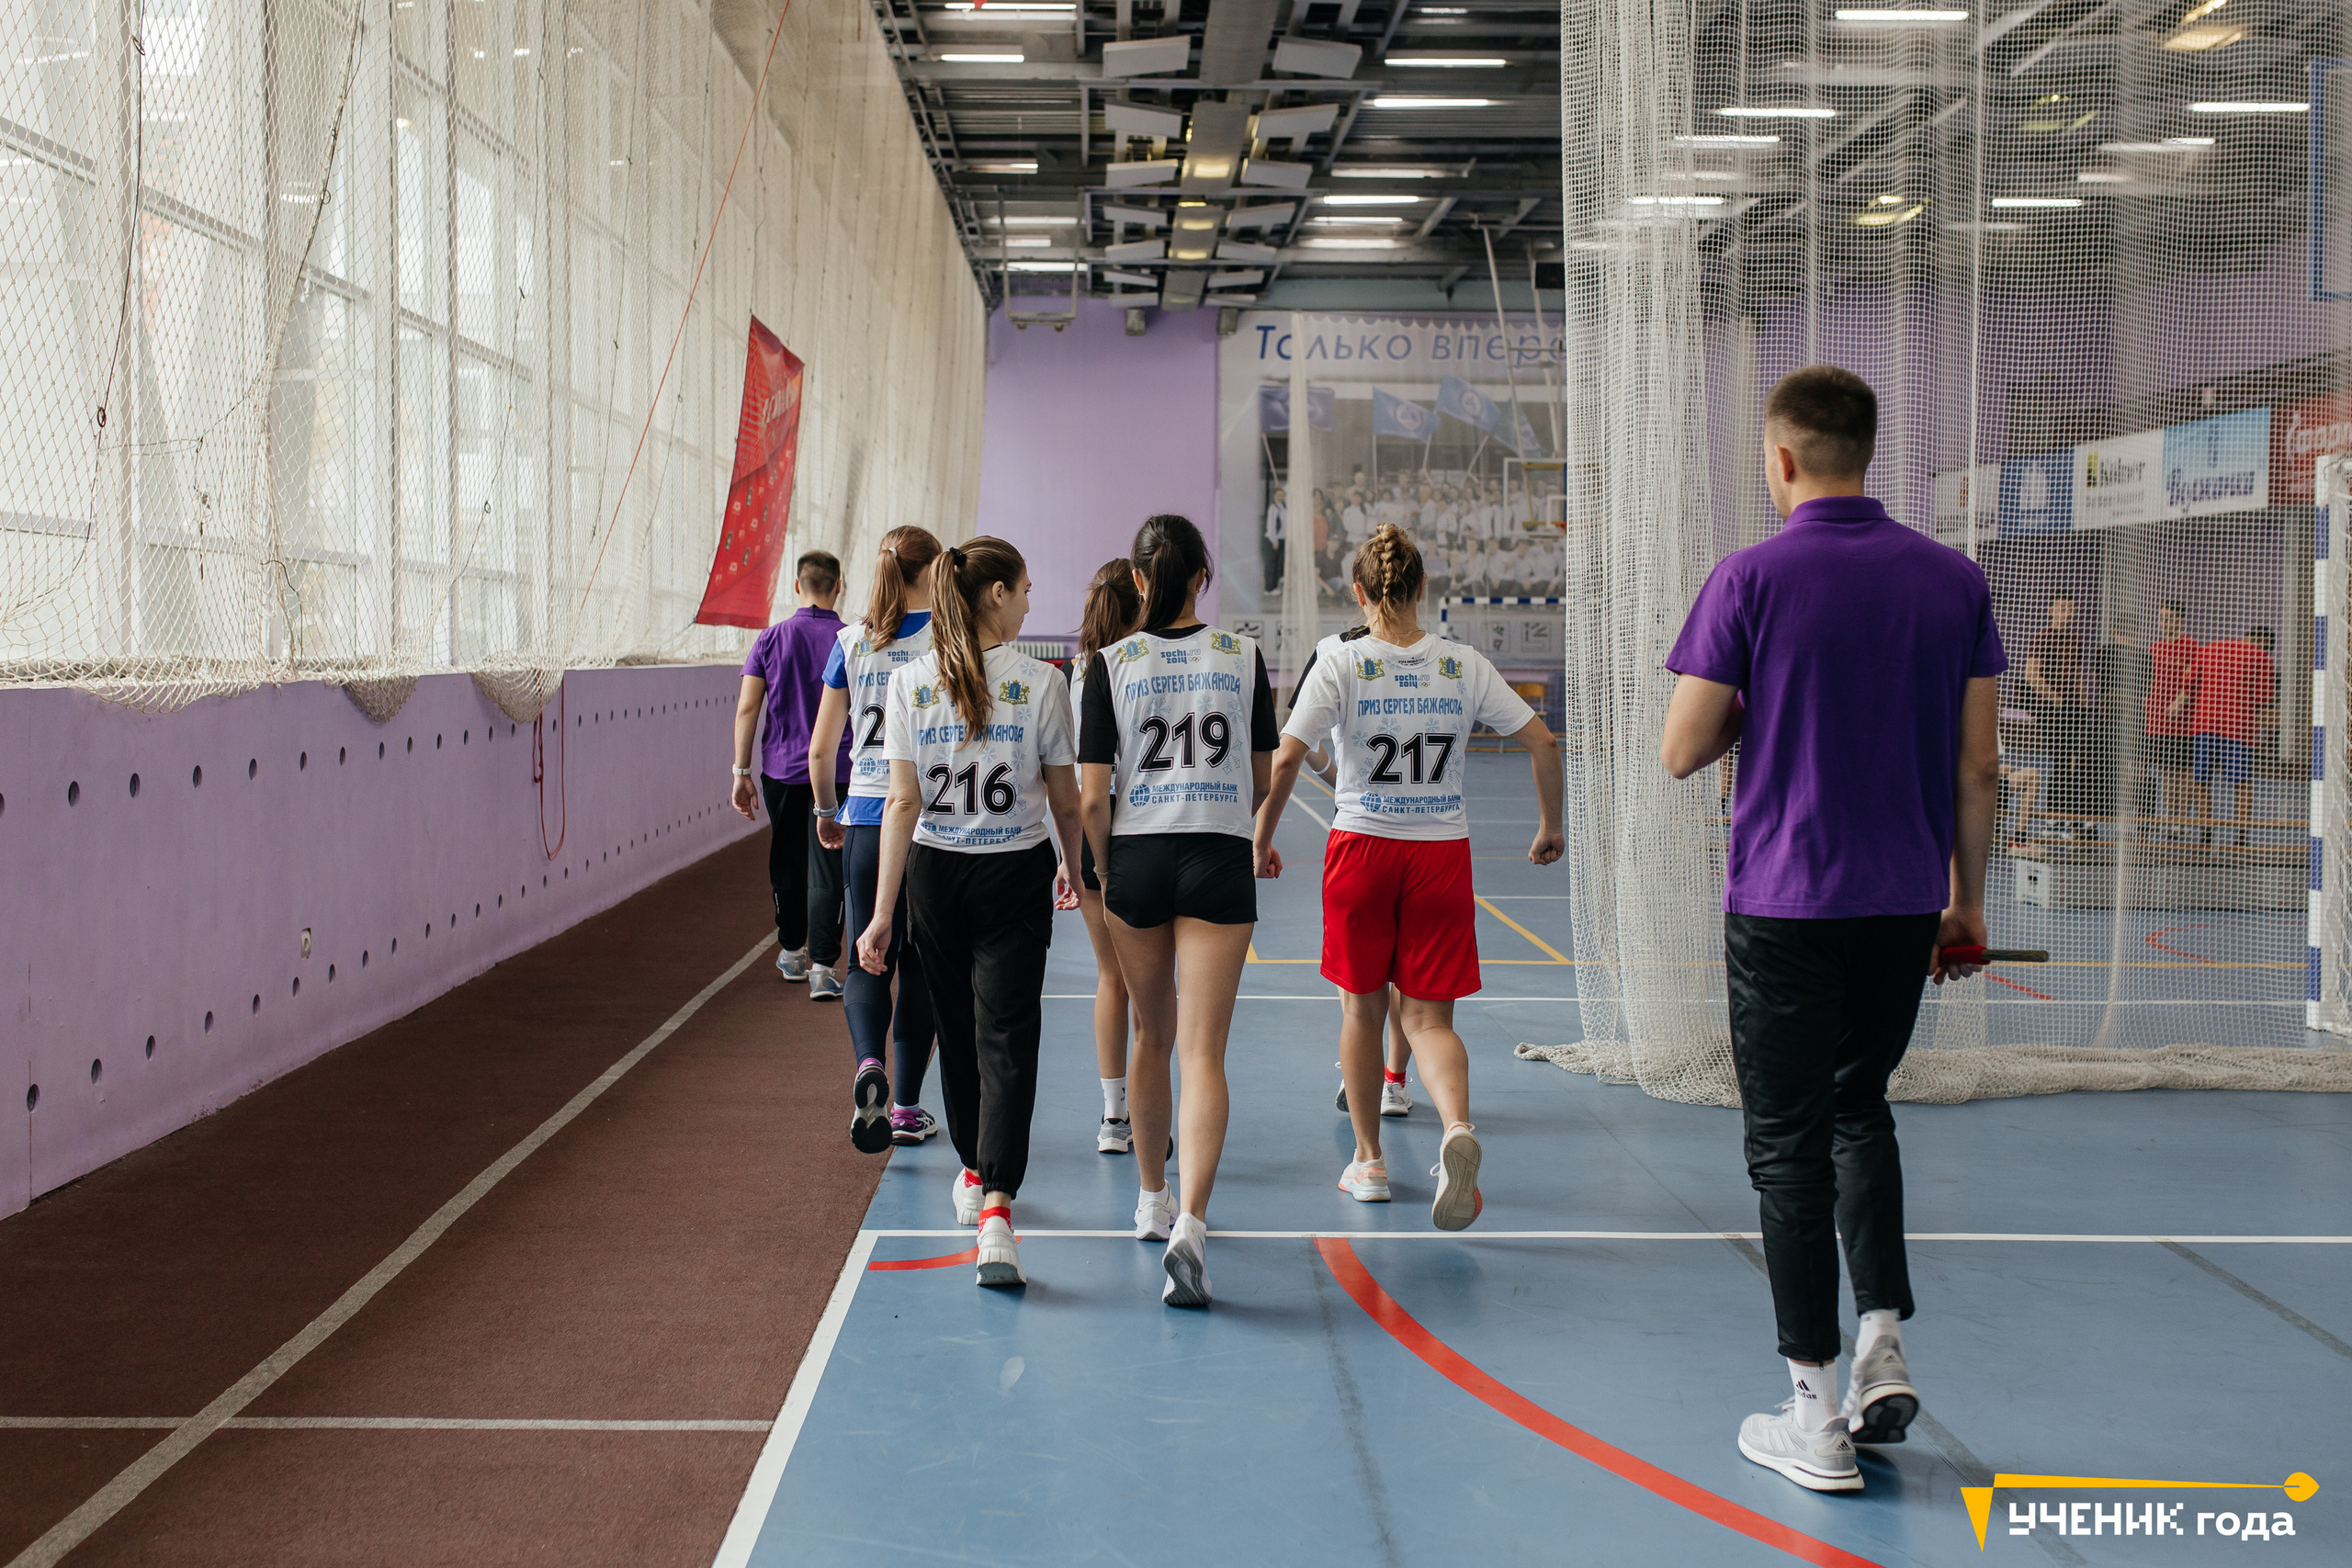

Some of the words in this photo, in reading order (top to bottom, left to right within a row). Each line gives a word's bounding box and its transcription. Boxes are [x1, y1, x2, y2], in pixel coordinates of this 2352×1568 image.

[1256, 325, 1412, 361] Только
[1125, 678, 1149, 704] ПРИЗ
[1151, 674, 1184, 694] СЕРГЕЯ
[1187, 671, 1240, 694] БАЖАНОВА
[1398, 681, 1418, 689] 2014
[1358, 699, 1381, 717] ПРИЗ
[1383, 698, 1415, 716] СЕРГЕЯ
[1417, 697, 1463, 716] БАЖАНОВА
[1137, 711, 1232, 773] 219
[1366, 733, 1457, 784] 217
[925, 761, 1017, 816] 216
[1152, 781, 1220, 793] МЕЖДУНАРОДНЫЙ
[1222, 783, 1238, 792] БАНК
[1151, 793, 1238, 804] САНКТ-ПЕТЕРБУРГА
[1383, 794, 1446, 805] МЕЖДУНАРОДНЫЙ
[1382, 804, 1461, 814] САНКТ-ПЕТЕРБУРГА
[938, 825, 1003, 836] МЕЖДУНАРОДНЫЙ
